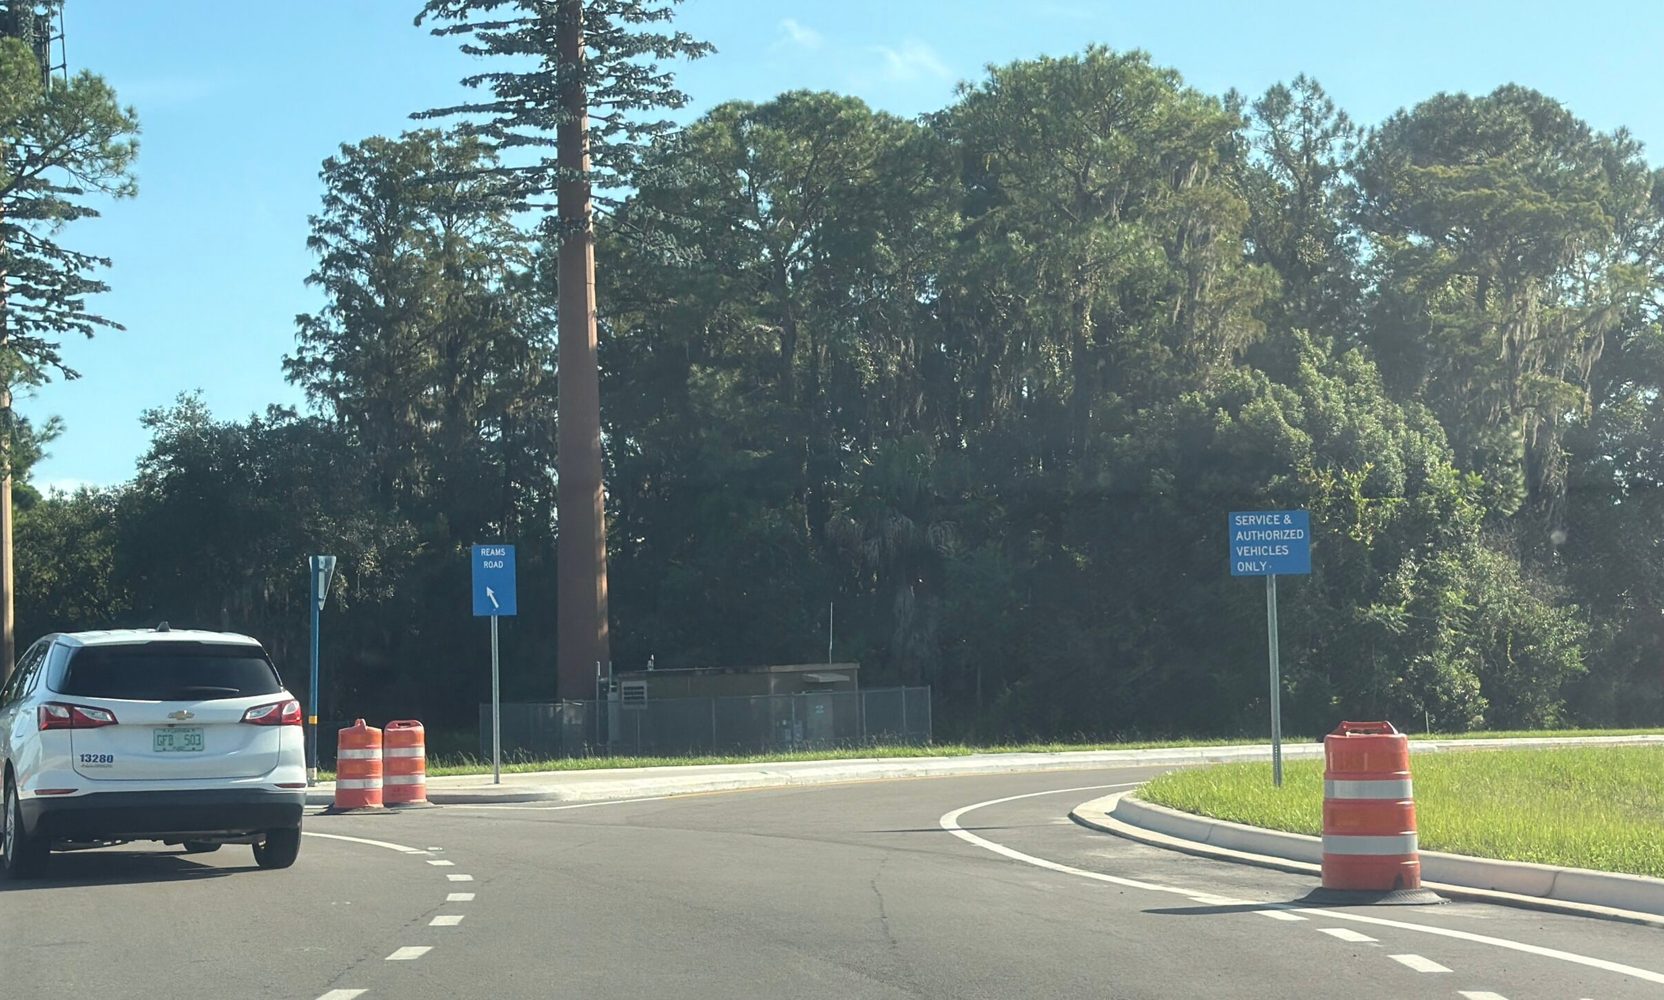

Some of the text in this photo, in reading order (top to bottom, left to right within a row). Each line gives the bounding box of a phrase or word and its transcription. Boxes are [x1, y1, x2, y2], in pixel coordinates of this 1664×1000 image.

[1235, 514, 1292, 526] SERVICE &
[1236, 529, 1304, 541] AUTHORIZED
[480, 548, 506, 558] REAMS
[1236, 545, 1289, 556] VEHICLES
[483, 561, 504, 570] ROAD
[1237, 561, 1267, 572] ONLY
[184, 734, 202, 746] 503
[80, 754, 113, 764] 13280
